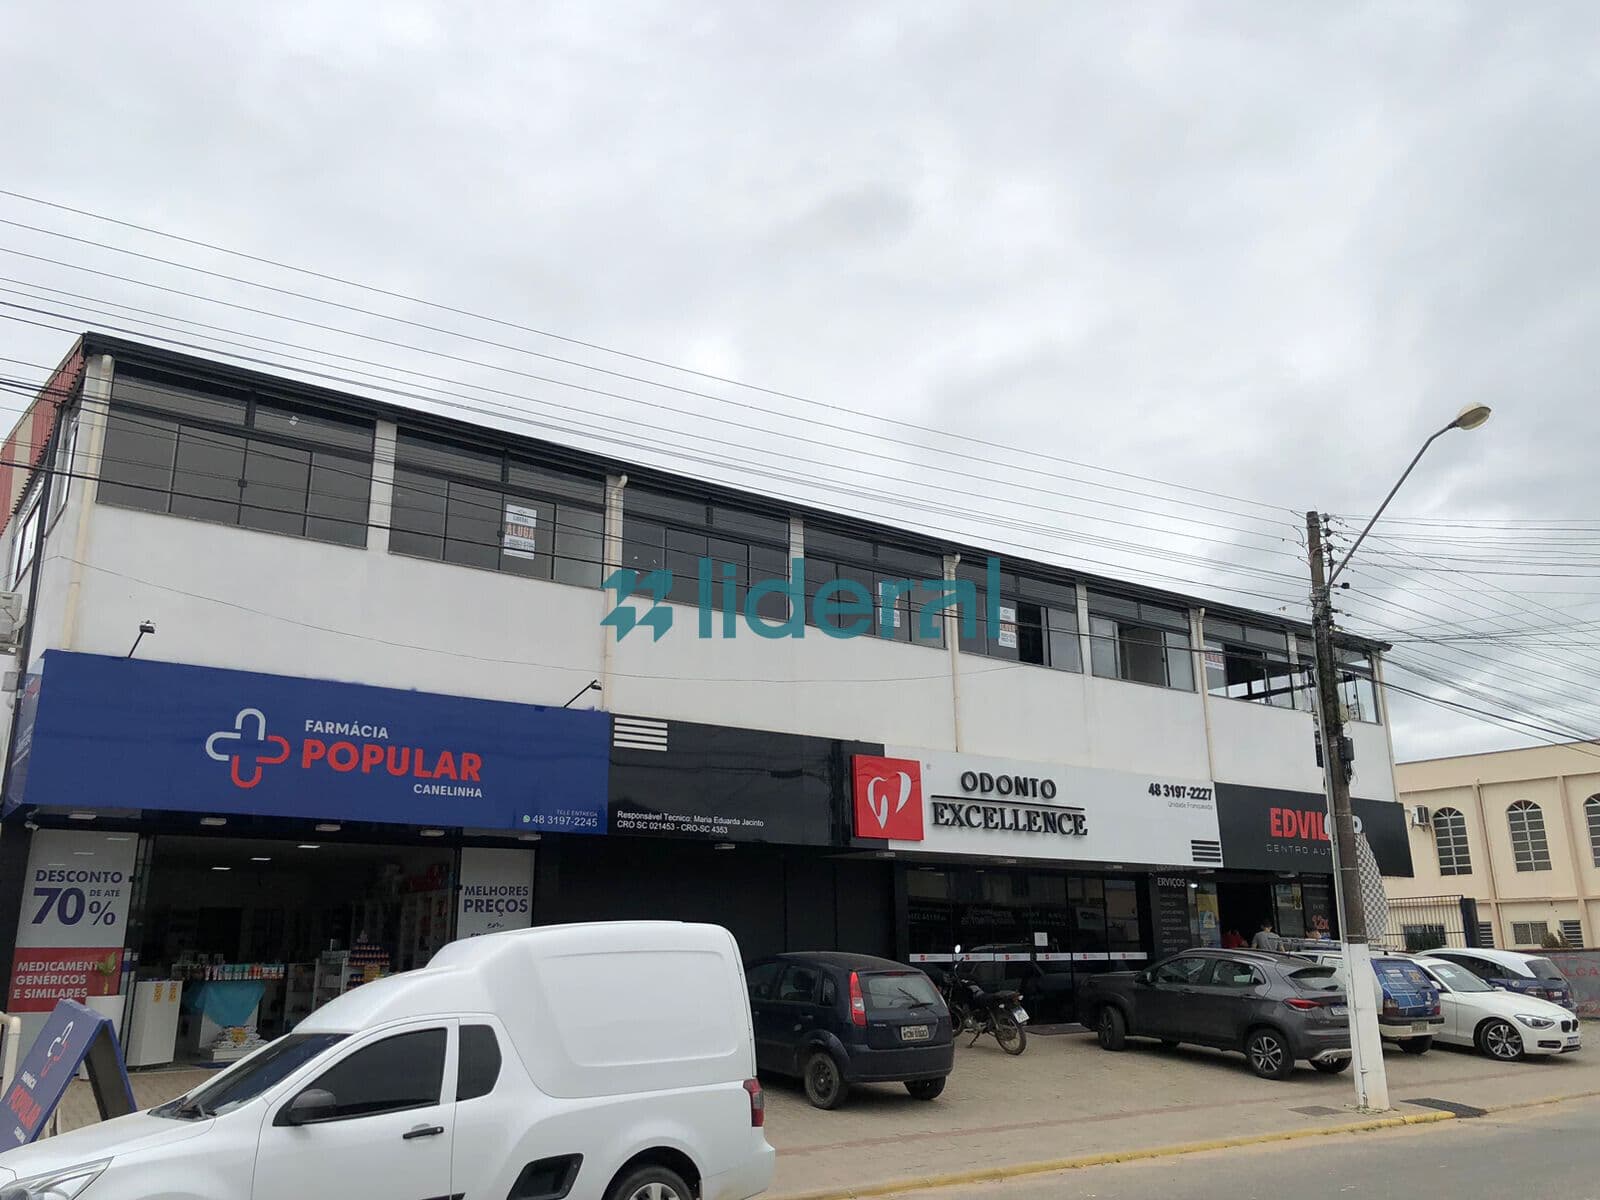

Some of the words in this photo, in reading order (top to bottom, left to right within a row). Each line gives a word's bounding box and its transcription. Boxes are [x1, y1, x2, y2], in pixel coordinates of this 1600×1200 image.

[304, 719, 389, 739] FARMÁCIA
[301, 738, 483, 782] POPULAR
[413, 783, 483, 798] CANELINHA
[960, 771, 1057, 799] ODONTO
[1148, 783, 1161, 796] 48
[1163, 784, 1212, 801] 3197-2227
[532, 815, 545, 824] 48
[547, 816, 598, 827] 3197-2245
[617, 820, 635, 829] CRO
[636, 821, 648, 829] SC
[694, 815, 713, 823] Maria
[714, 816, 740, 825] Eduarda
[742, 818, 764, 827] Jacinto
[932, 801, 1088, 836] EXCELLENCE
[1266, 844, 1309, 855] CENTRO
[35, 869, 123, 884] DESCONTO
[90, 889, 102, 897] DE
[464, 886, 529, 896] MELHORES
[463, 899, 528, 917] PREÇOS
[15, 972, 87, 985] GENÉRICOS
[13, 989, 22, 999] E
[24, 988, 88, 999] SIMILARES
